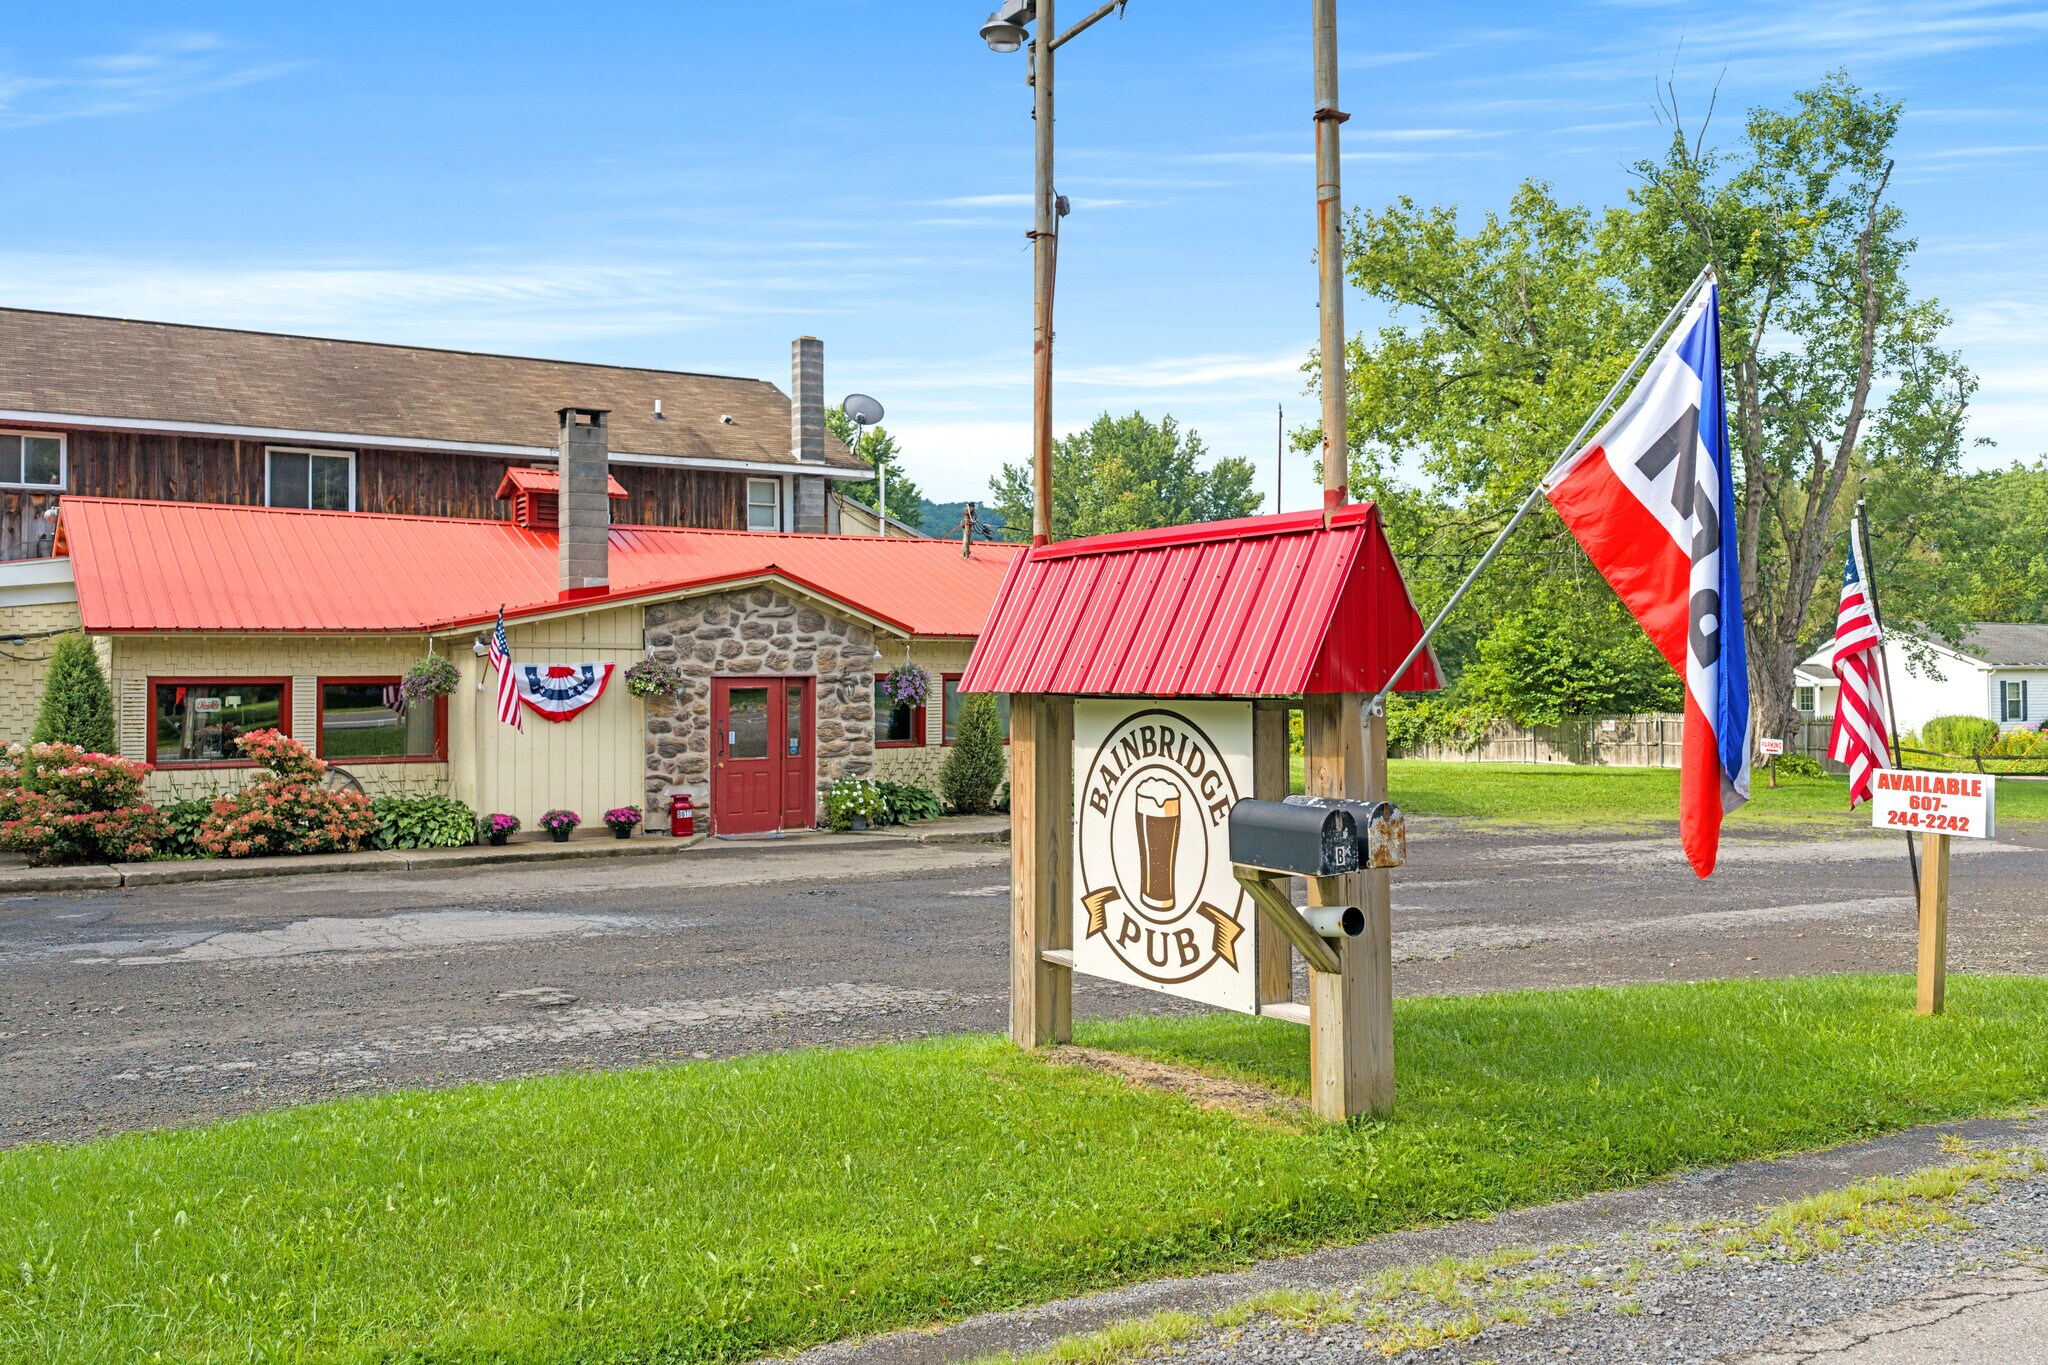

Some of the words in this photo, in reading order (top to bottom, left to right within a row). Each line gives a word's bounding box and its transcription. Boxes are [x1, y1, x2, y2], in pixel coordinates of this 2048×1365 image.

[1761, 741, 1782, 750] PARKING
[1089, 724, 1230, 827] BAINBRIDGE
[1877, 773, 1982, 798] AVAILABLE
[1909, 795, 1948, 812] 607-
[1887, 810, 1970, 832] 244-2242
[1116, 912, 1201, 968] PUB
